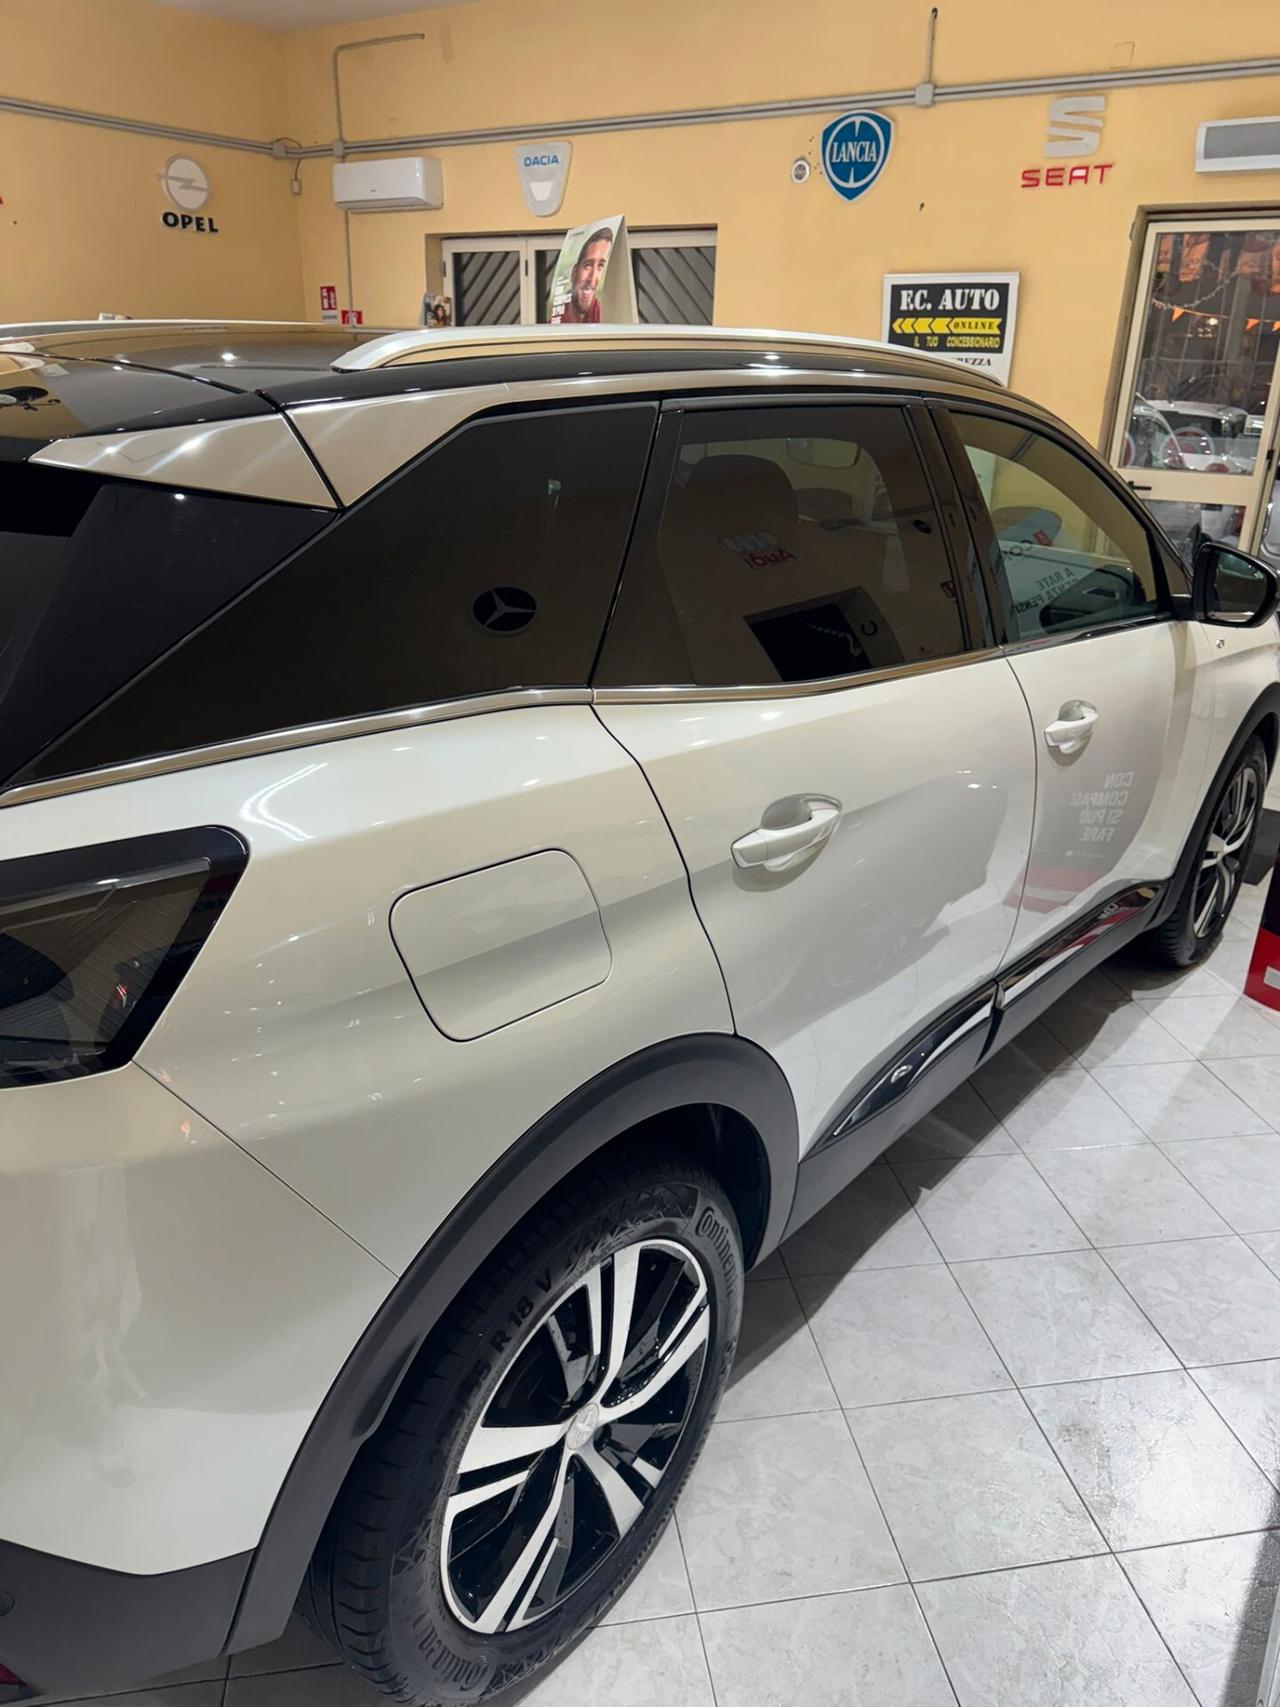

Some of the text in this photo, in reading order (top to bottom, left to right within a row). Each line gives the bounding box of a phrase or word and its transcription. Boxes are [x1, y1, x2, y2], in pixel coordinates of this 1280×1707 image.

[523, 154, 560, 167] DACIA
[831, 141, 877, 163] LANCIA
[1021, 164, 1113, 188] SEAT
[161, 211, 219, 233] OPEL
[899, 288, 1001, 311] F.C. AUTO
[952, 320, 996, 331] ONLINE
[926, 336, 939, 347] TUO
[508, 1296, 534, 1328] 18
